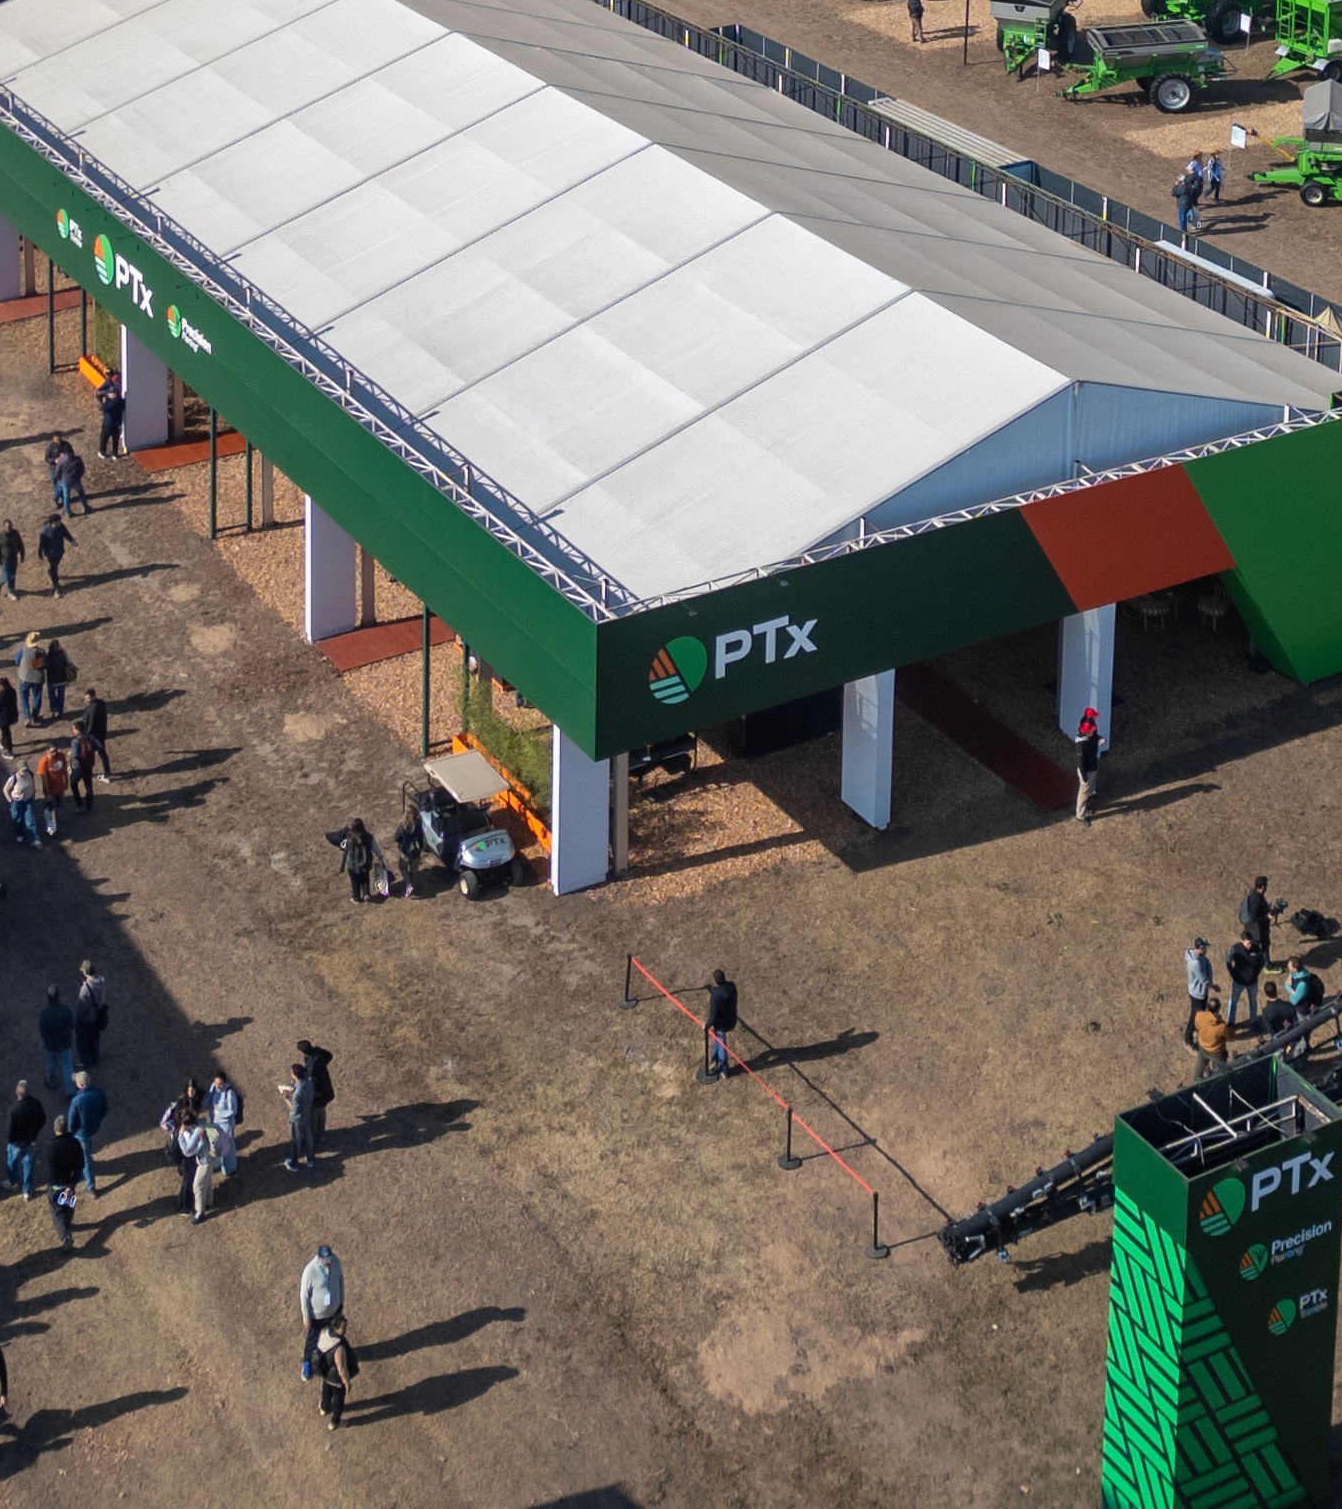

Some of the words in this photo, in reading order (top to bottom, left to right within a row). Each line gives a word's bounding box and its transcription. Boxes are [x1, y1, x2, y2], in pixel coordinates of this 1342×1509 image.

[115, 253, 154, 319] PTx
[715, 615, 819, 680] PTx
[1248, 1151, 1335, 1212] PTx
[1271, 1219, 1333, 1255] Precision
[1299, 1288, 1328, 1310] PTx
